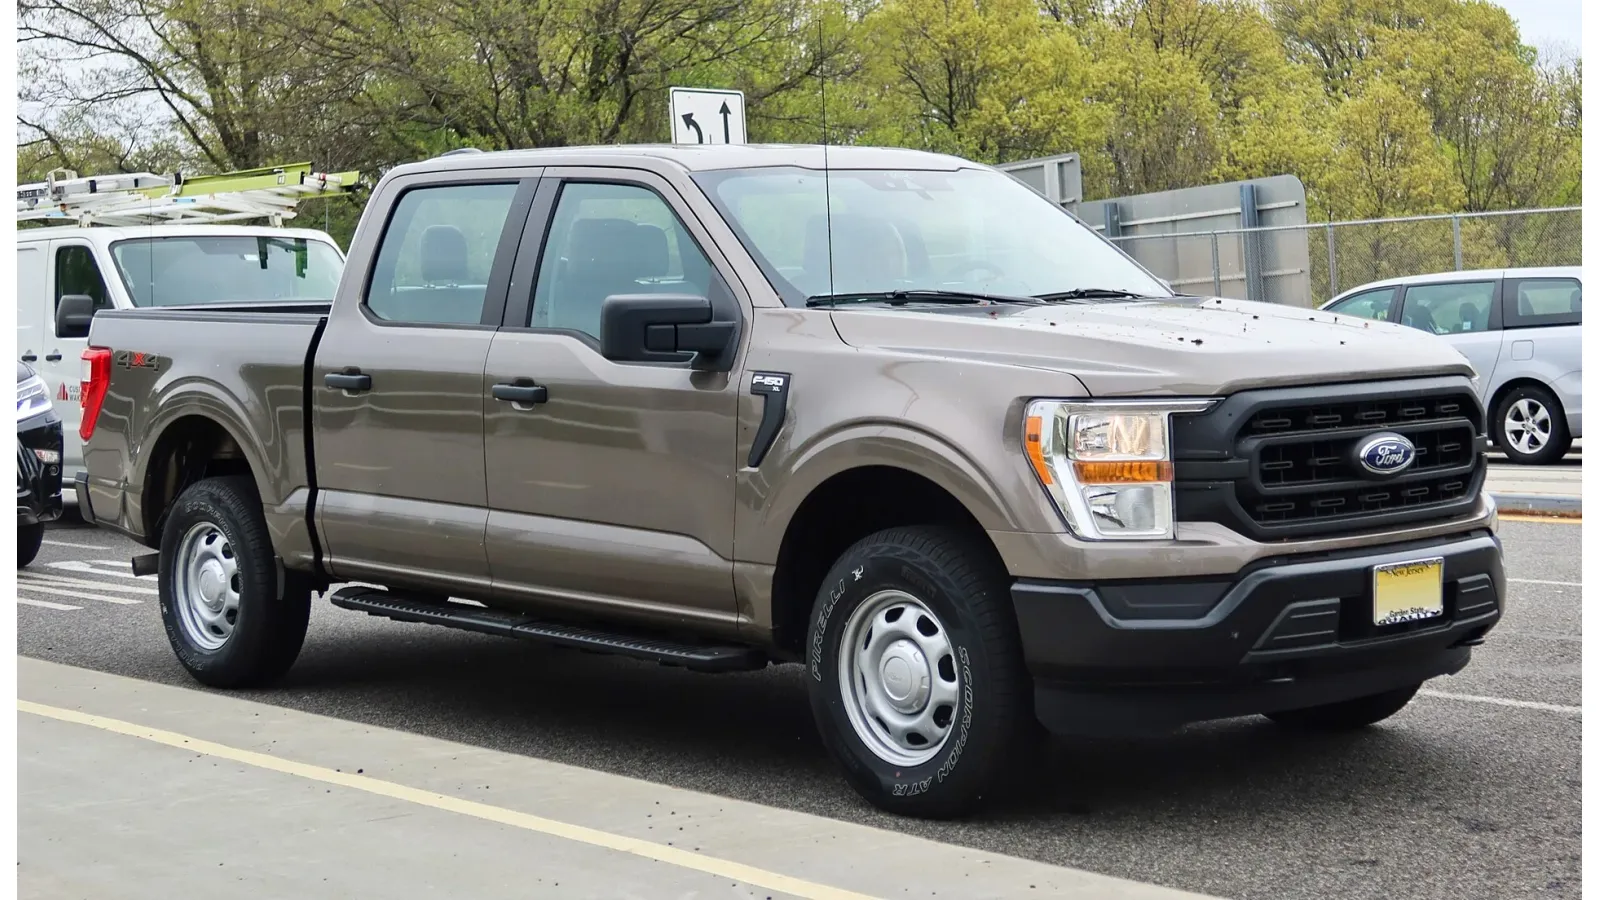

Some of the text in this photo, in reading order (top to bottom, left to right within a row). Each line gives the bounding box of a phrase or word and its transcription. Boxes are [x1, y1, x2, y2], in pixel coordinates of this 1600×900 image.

[1375, 445, 1405, 466] Ford
[1391, 568, 1405, 577] New
[1405, 566, 1424, 577] Jersey
[811, 578, 847, 682] PIRELLI
[892, 645, 974, 796] SCORPION ATR
